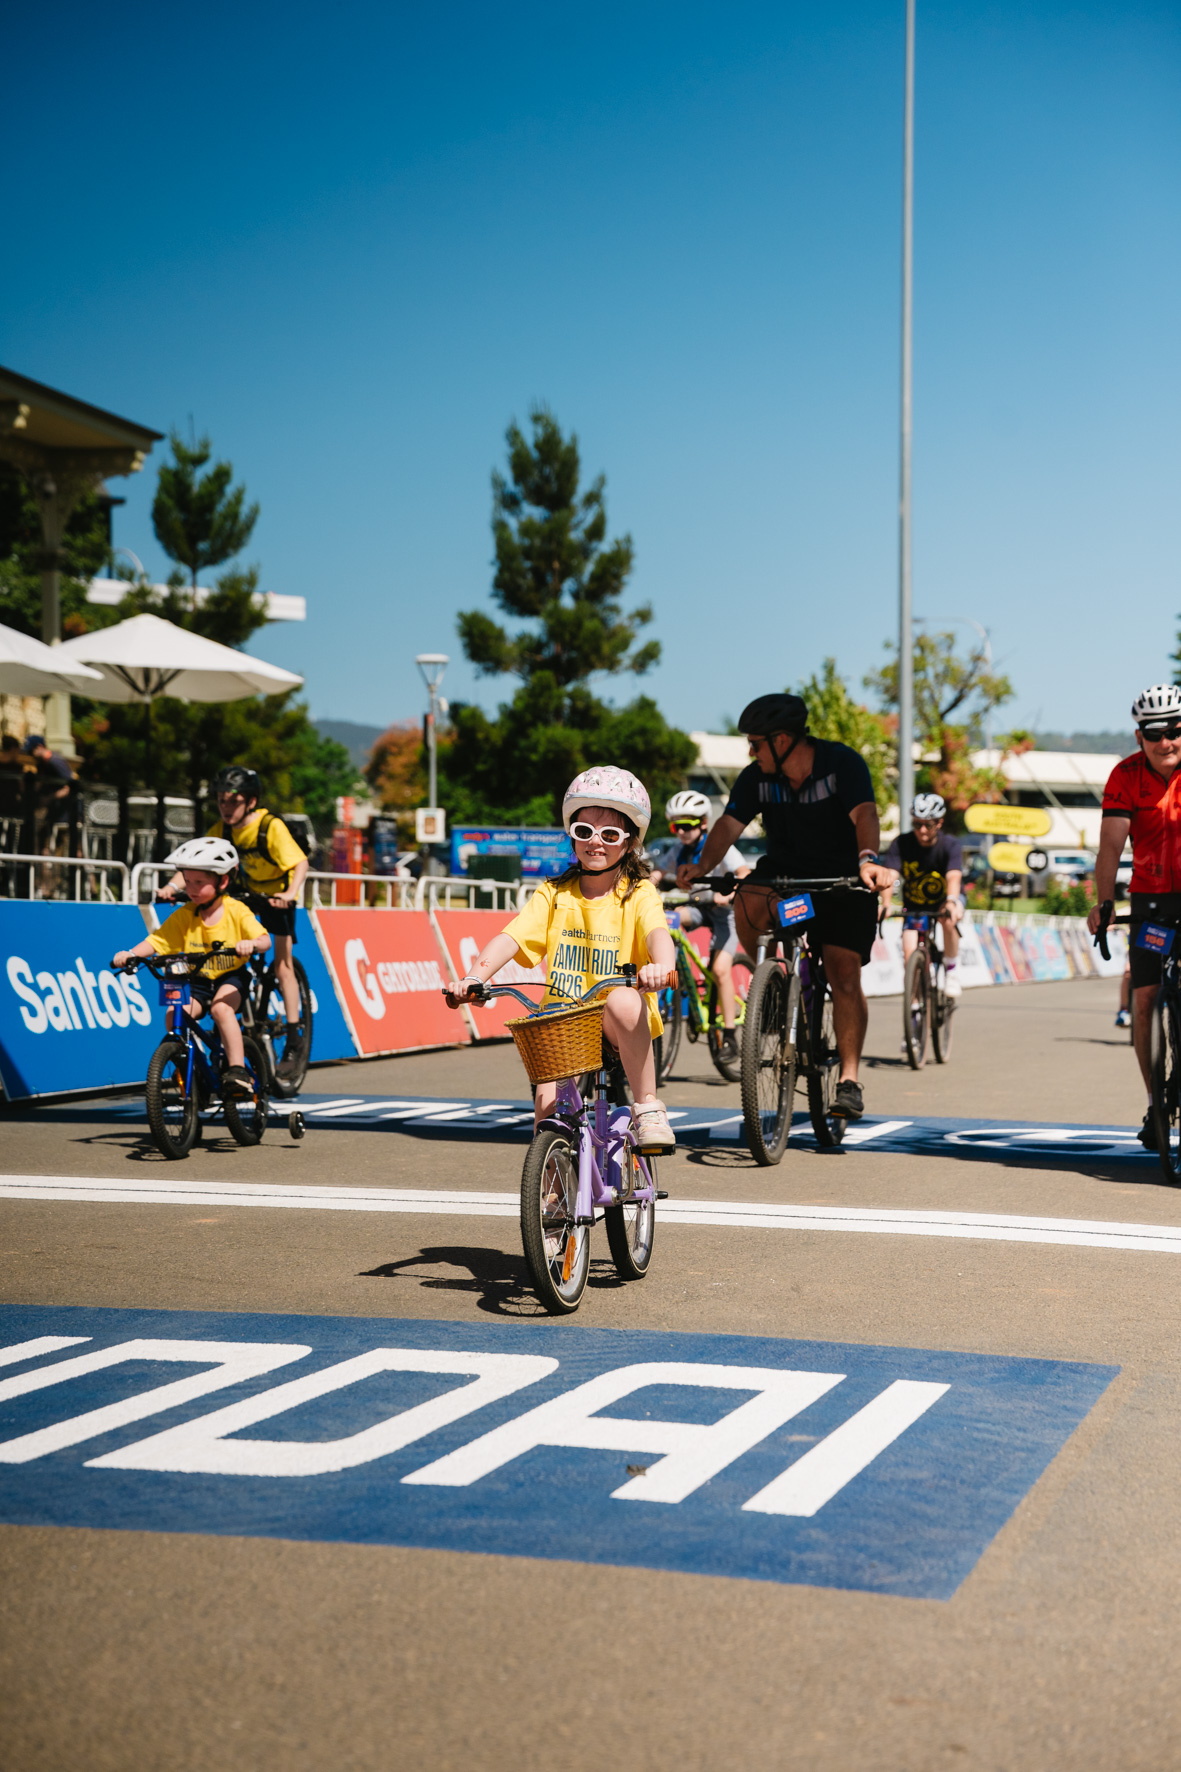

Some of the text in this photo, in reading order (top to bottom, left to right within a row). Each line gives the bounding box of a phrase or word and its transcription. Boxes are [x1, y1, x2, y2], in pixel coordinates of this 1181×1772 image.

[784, 905, 808, 919] 200
[561, 928, 621, 943] ealthPartners
[553, 943, 591, 973] FAMILY
[591, 948, 621, 975] RIDE
[6, 955, 151, 1034] Santos
[548, 971, 583, 999] 2026
[0, 1336, 952, 1518] NDAI
